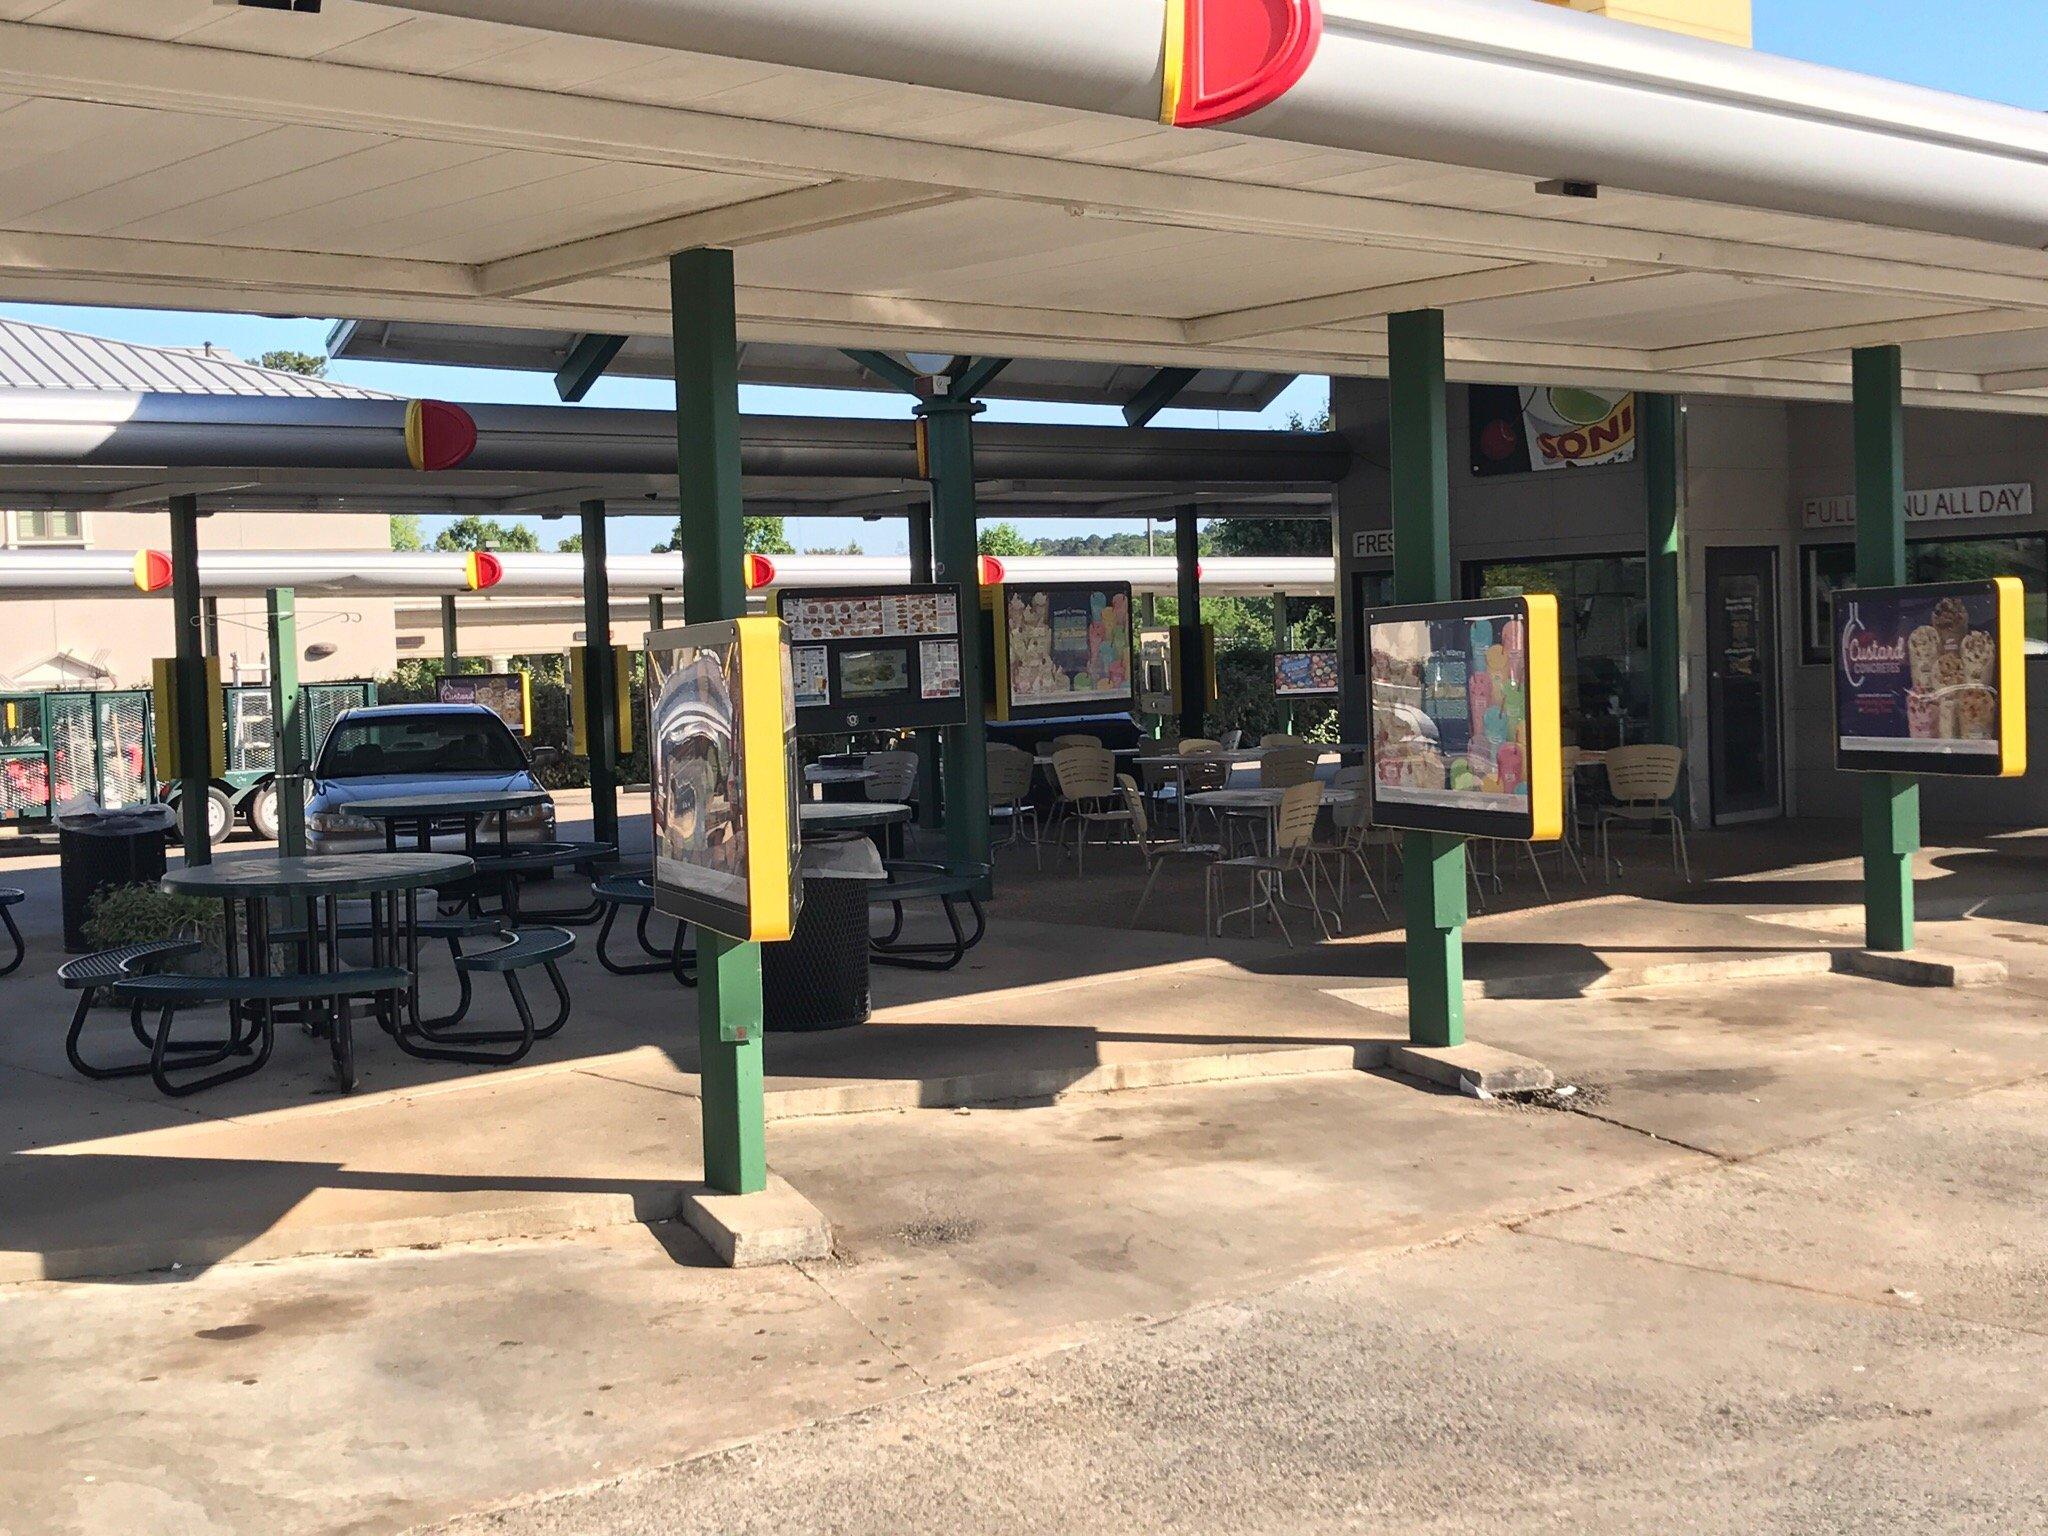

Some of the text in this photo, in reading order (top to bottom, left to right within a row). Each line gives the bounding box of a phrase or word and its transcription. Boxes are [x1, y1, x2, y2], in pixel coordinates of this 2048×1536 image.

[1934, 491, 1974, 515] ALL
[1979, 488, 2025, 513] DAY
[1850, 637, 1905, 661] Custard
